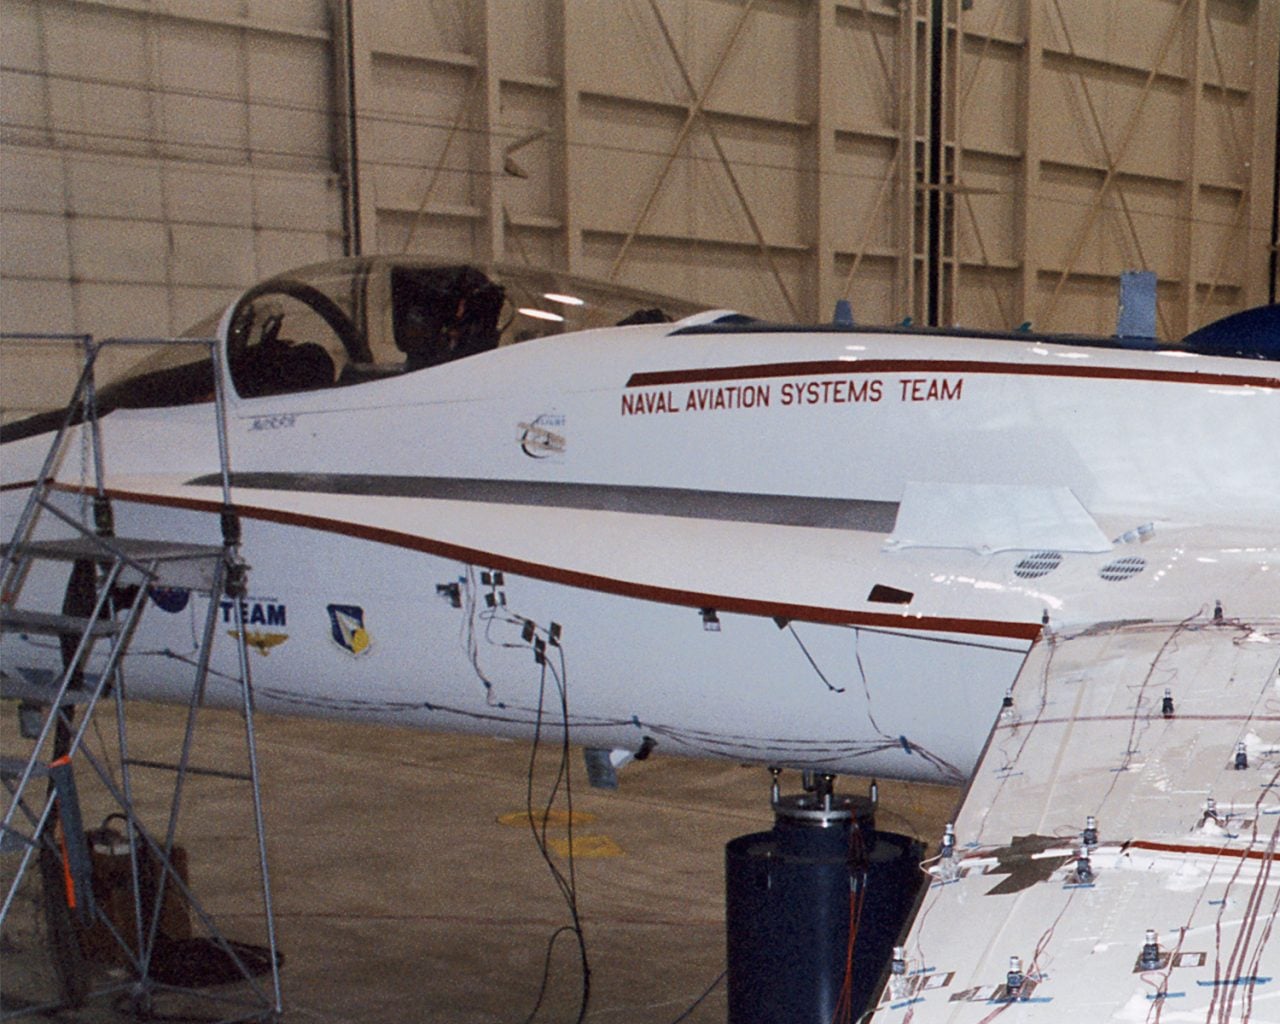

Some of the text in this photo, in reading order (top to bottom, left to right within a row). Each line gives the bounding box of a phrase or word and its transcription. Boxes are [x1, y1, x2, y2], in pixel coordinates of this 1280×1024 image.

[621, 378, 963, 416] NAVAL AVIATION SYSTEMS TEAM
[221, 602, 286, 626] TEAM
